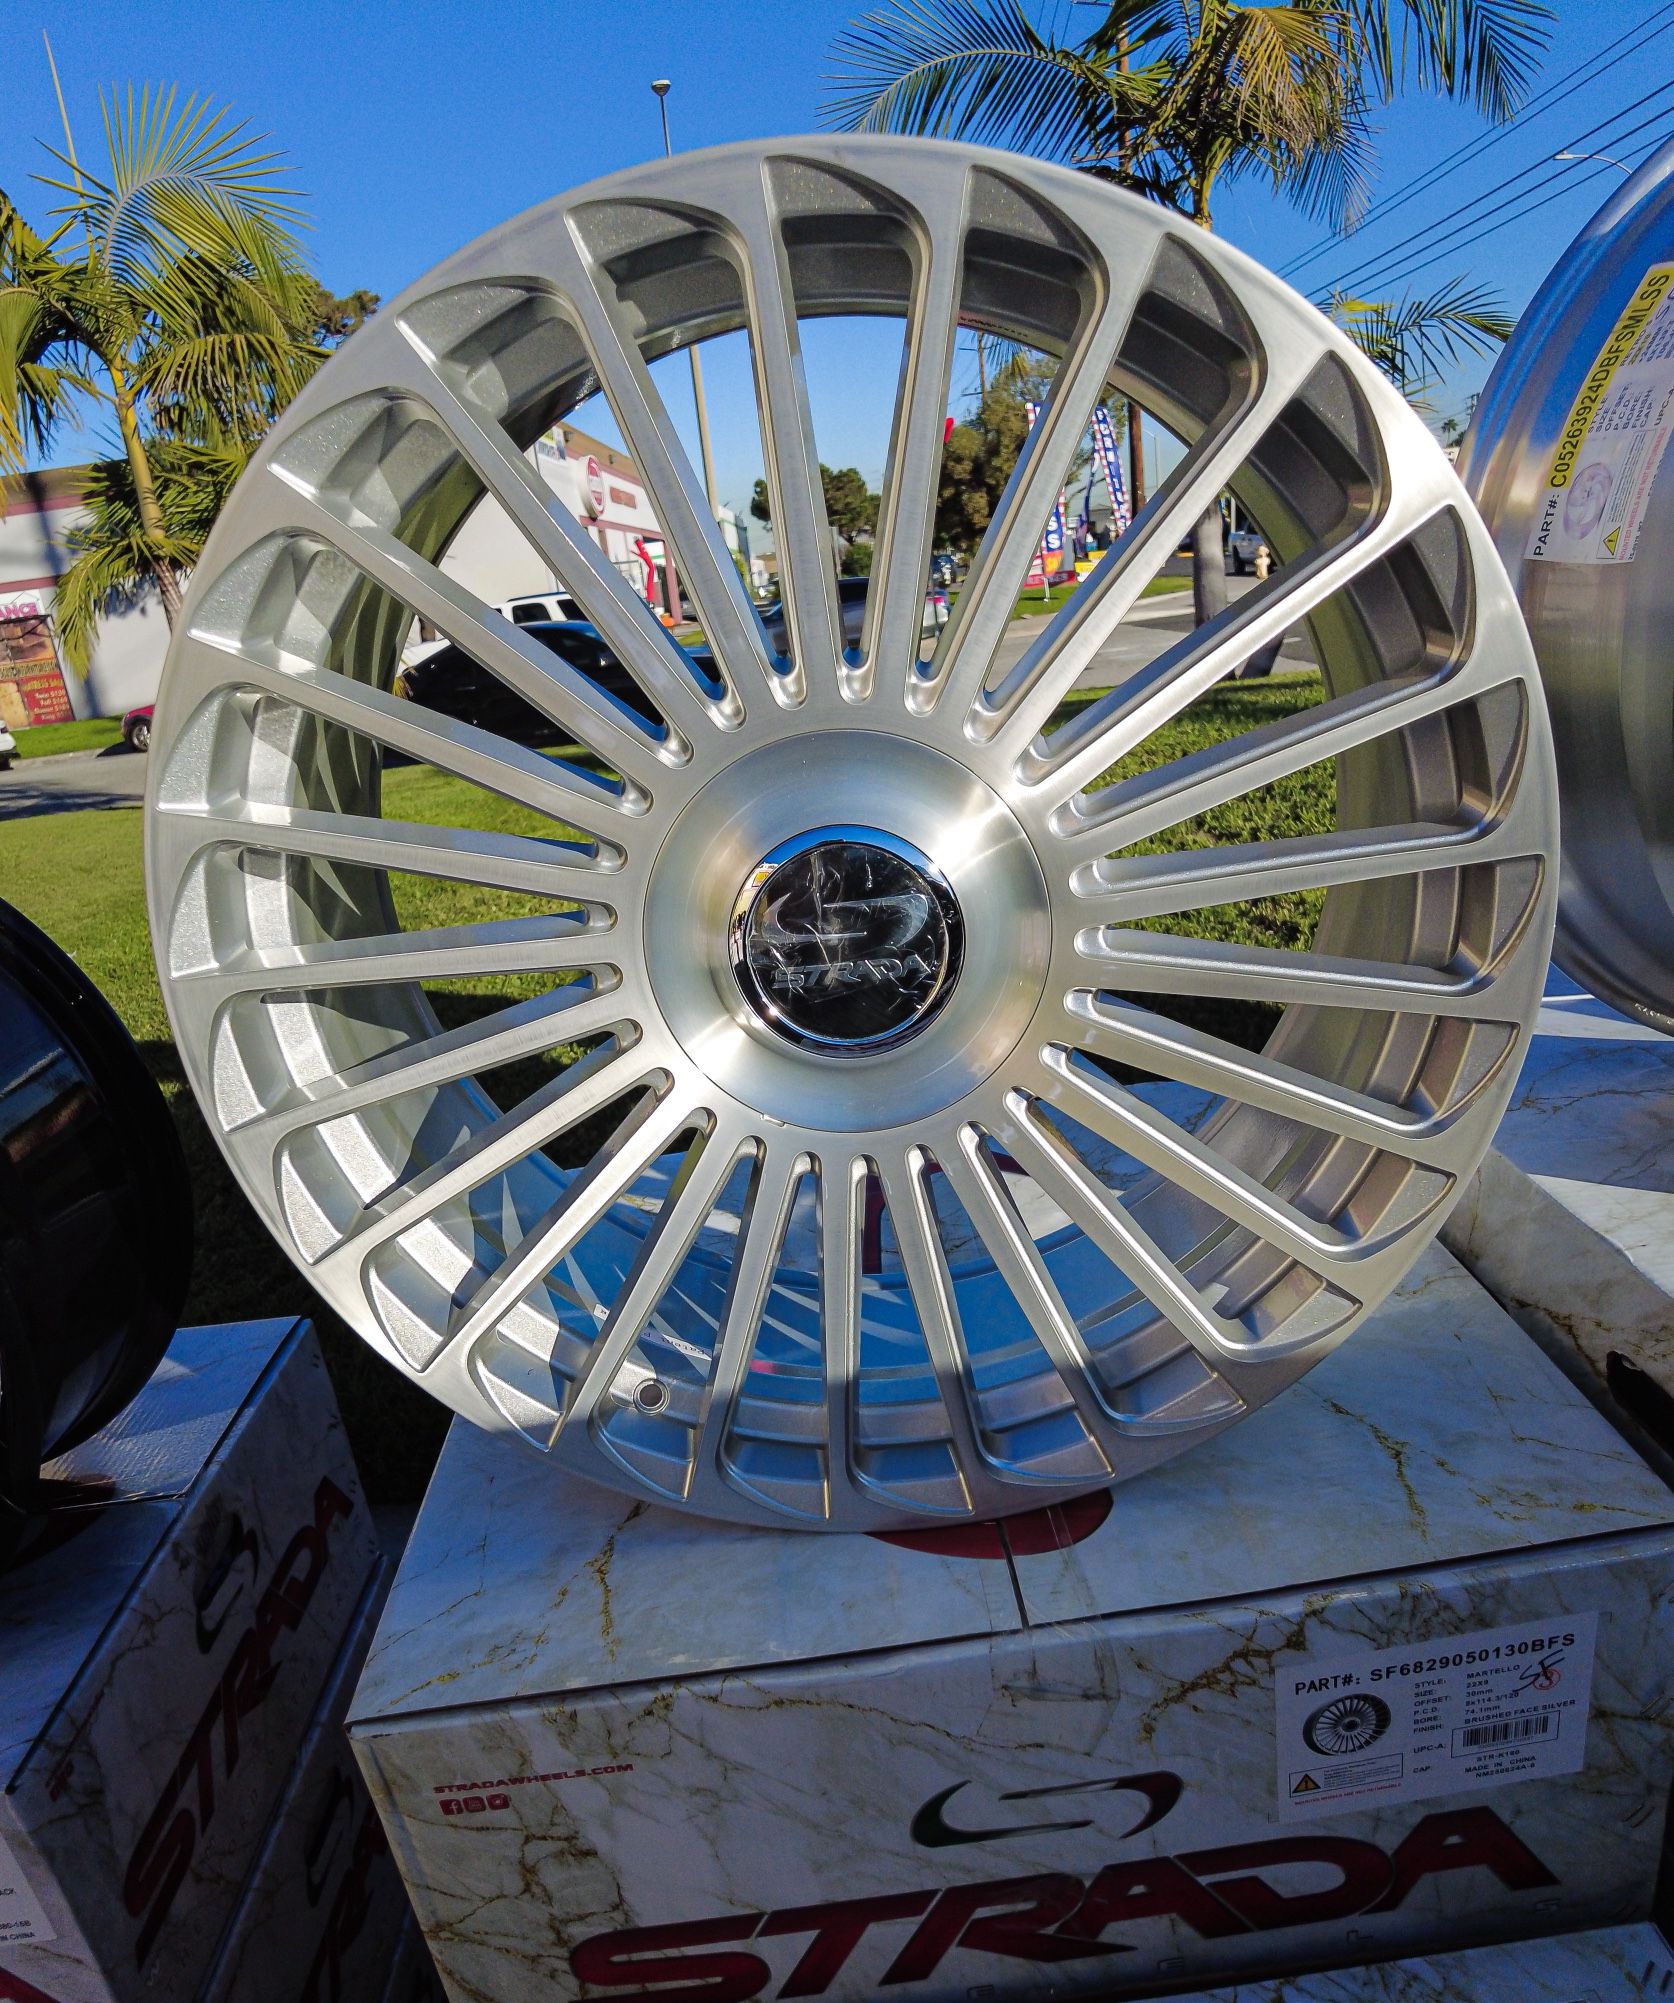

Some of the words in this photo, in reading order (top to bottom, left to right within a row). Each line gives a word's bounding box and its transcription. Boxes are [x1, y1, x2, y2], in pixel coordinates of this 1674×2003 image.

[1533, 494, 1560, 556] PART#:
[772, 953, 932, 990] STRADA
[1295, 1672, 1360, 1696] PART#:
[1370, 1633, 1576, 1682] SF6829050130BFS
[1466, 1664, 1521, 1680] MARTELLO
[1464, 1710, 1511, 1725] BRUSHED
[1513, 1705, 1539, 1718] FACE
[1541, 1699, 1576, 1711] SILVER
[433, 1763, 634, 1794] STRADAWHEELS.COM
[1464, 1764, 1488, 1773] MADE
[1509, 1755, 1537, 1765] CHINA
[568, 1805, 1558, 2003] STRADA
